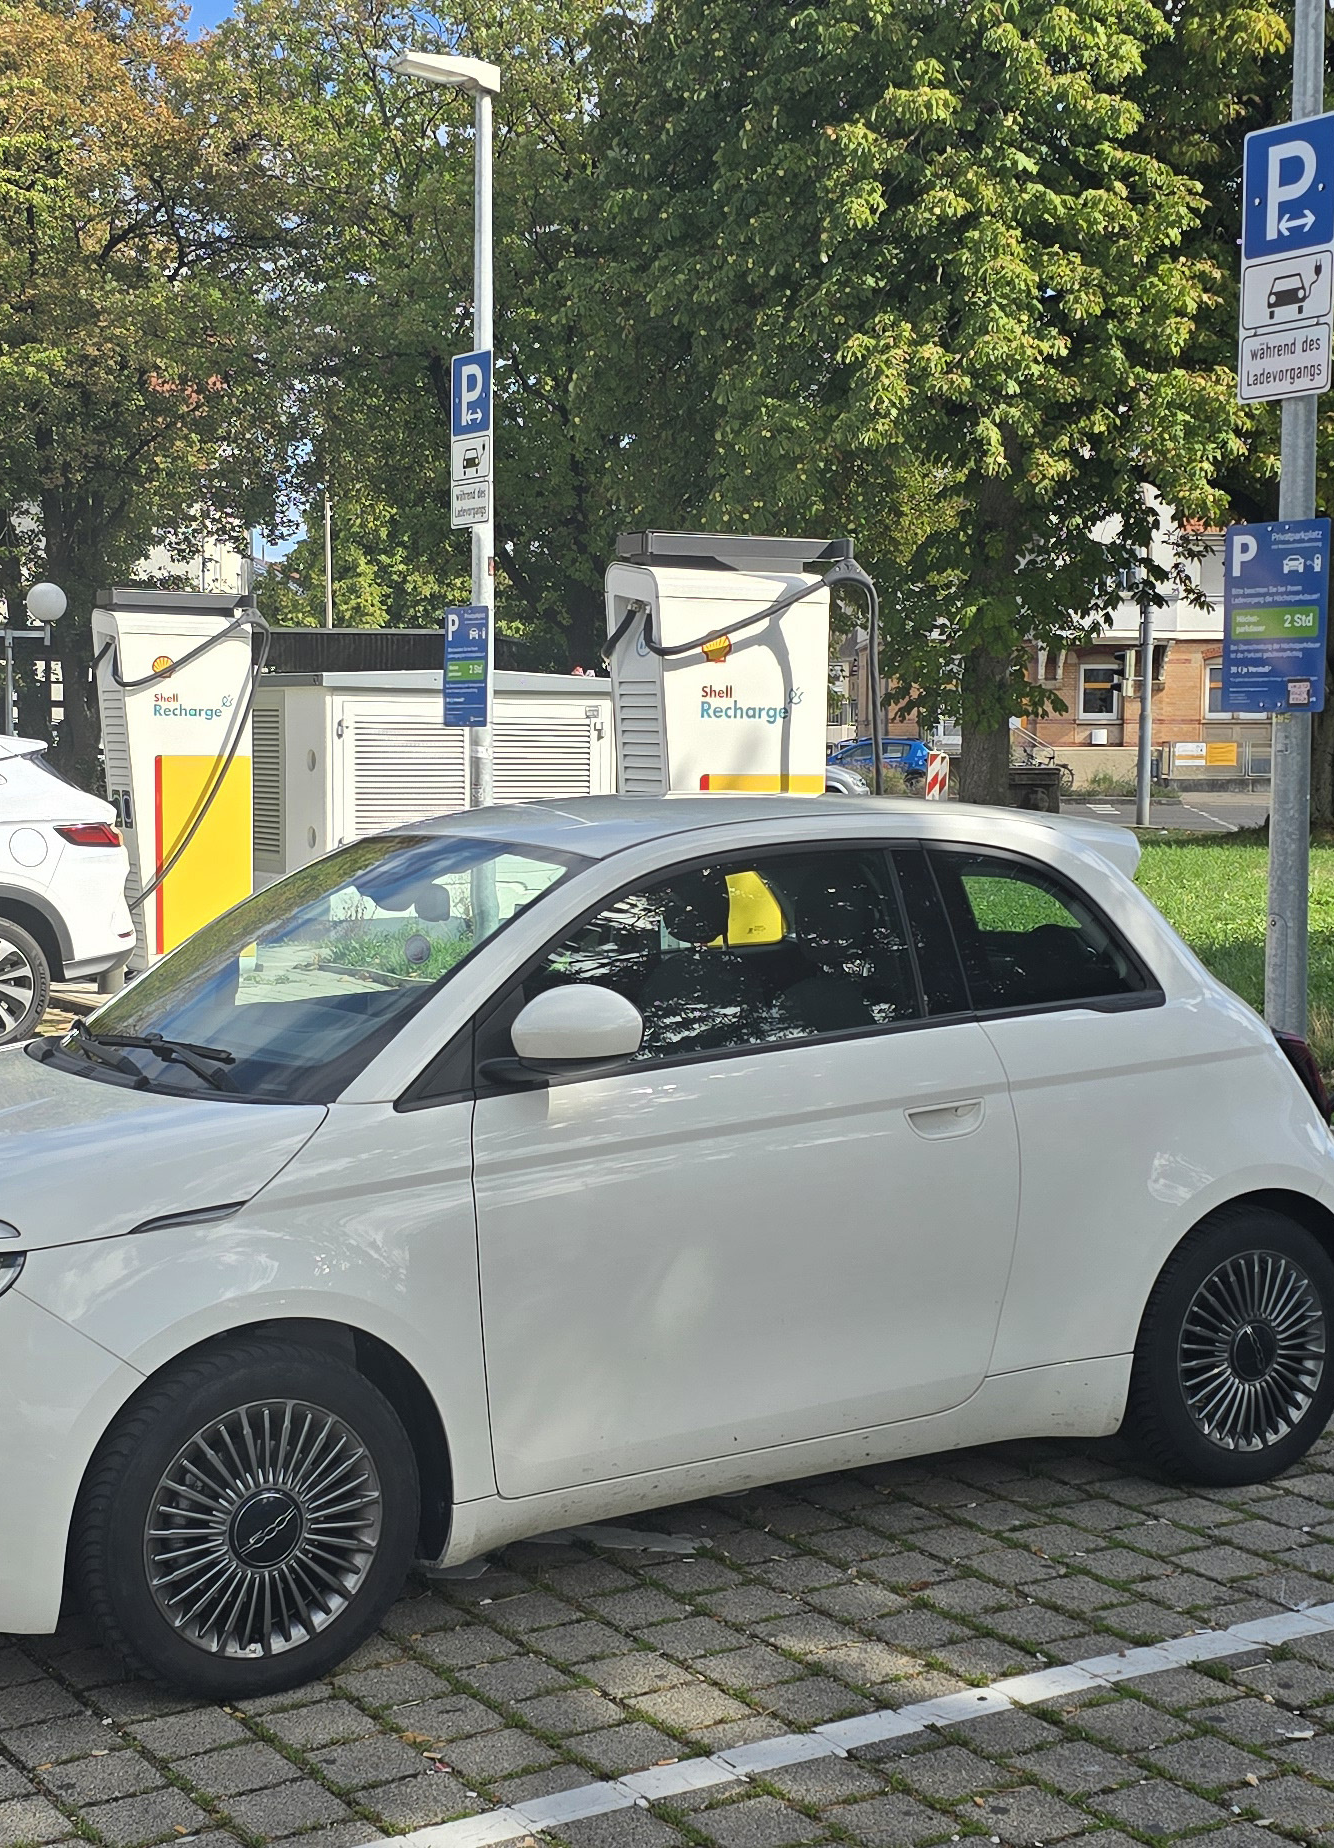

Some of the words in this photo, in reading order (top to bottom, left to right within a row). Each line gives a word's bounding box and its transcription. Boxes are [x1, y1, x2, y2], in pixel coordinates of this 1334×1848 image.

[1266, 140, 1317, 241] P
[1249, 337, 1297, 361] während
[1301, 335, 1321, 352] des
[1246, 365, 1323, 387] Ladevorgangs
[461, 364, 483, 426] P
[455, 488, 476, 502] während
[477, 487, 486, 499] des
[454, 505, 487, 520] Ladevorgangs
[1232, 535, 1258, 577] P
[448, 614, 459, 641] P
[1284, 614, 1292, 627] 2
[1293, 613, 1313, 627] Std
[154, 693, 179, 703] Shell
[701, 685, 733, 699] Shell
[153, 704, 222, 720] Recharge
[700, 700, 789, 724] Recharge
